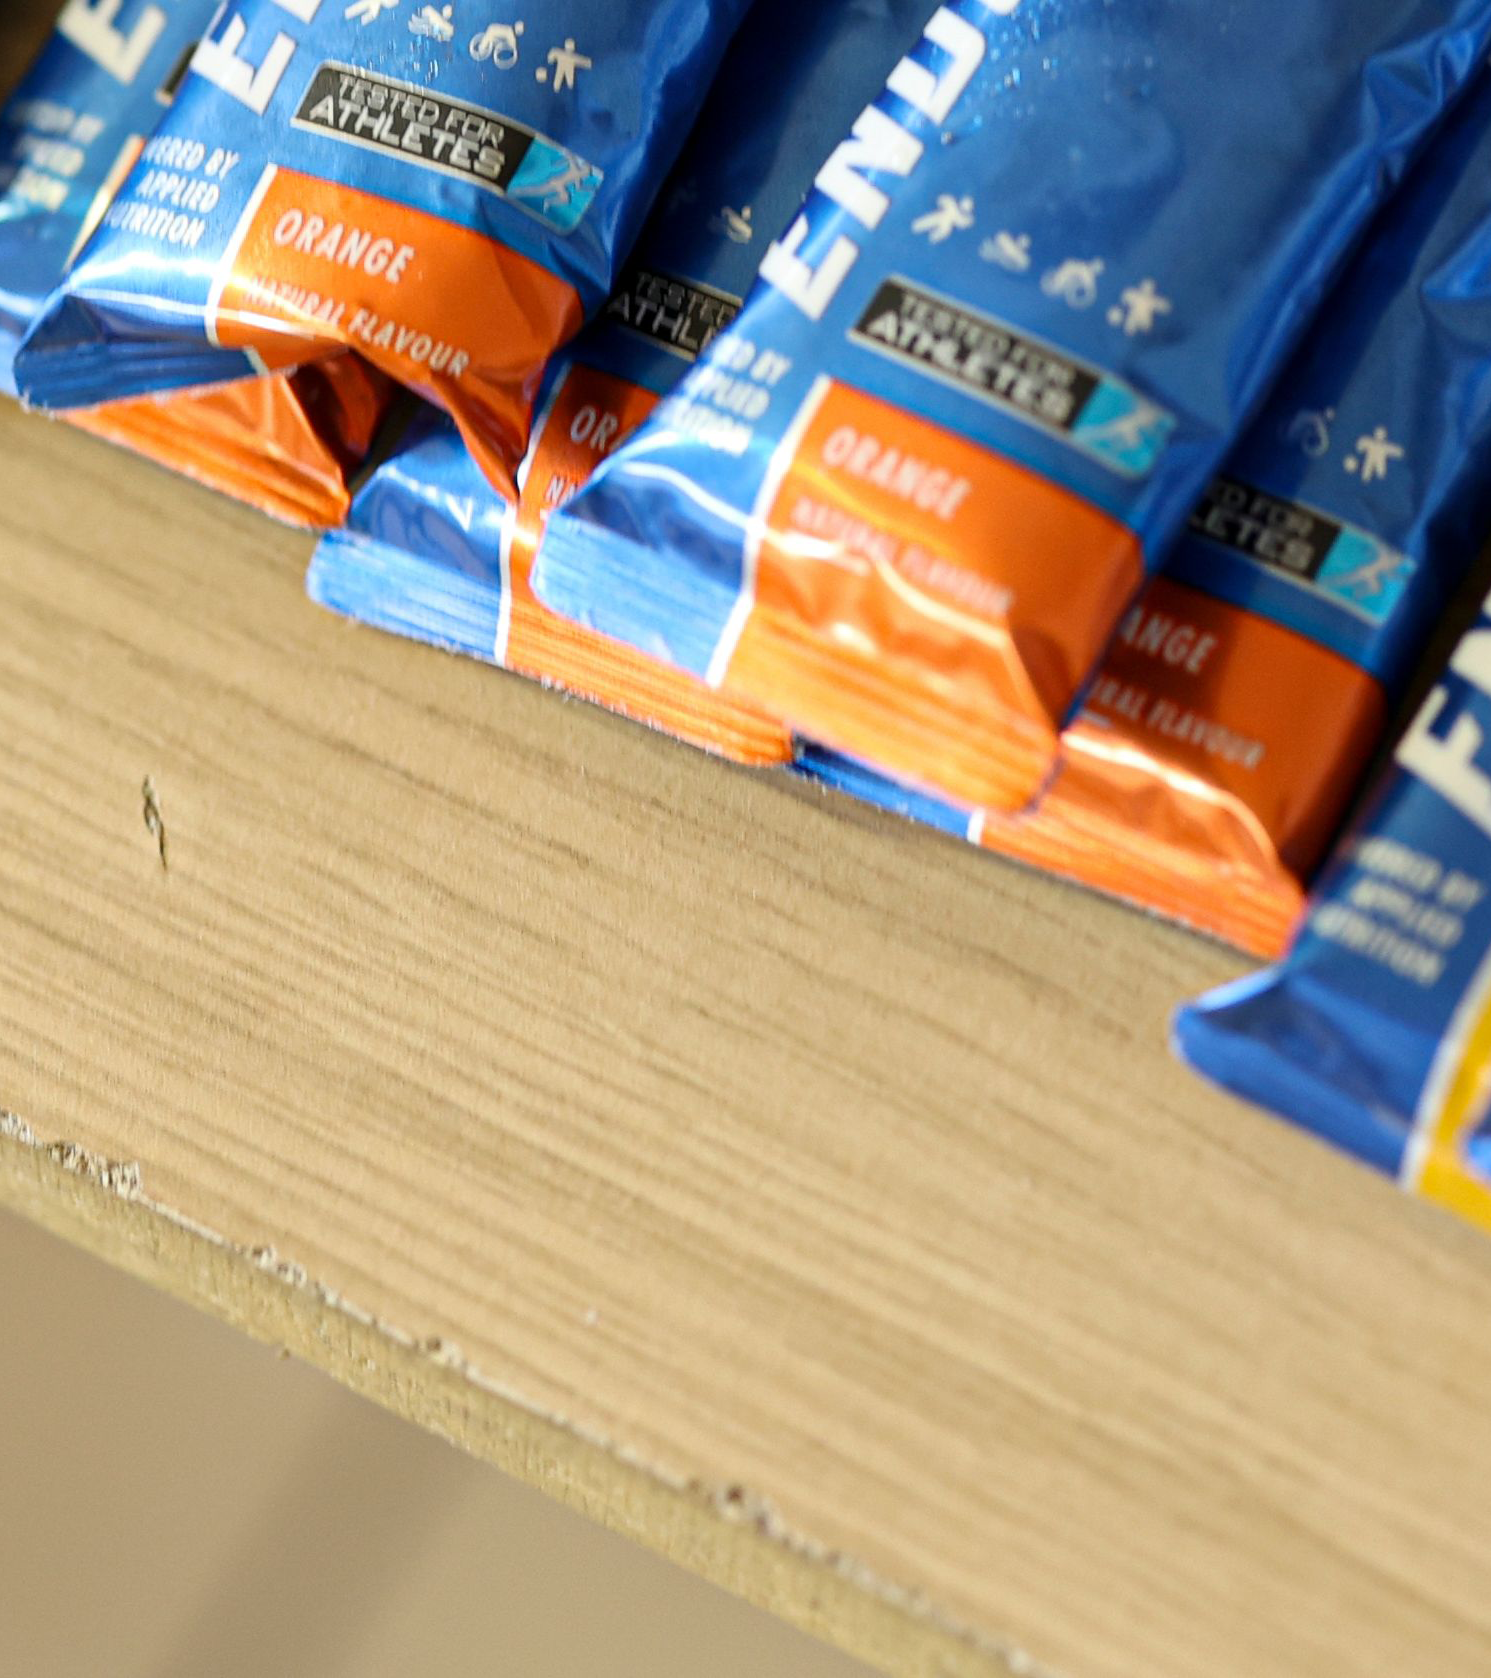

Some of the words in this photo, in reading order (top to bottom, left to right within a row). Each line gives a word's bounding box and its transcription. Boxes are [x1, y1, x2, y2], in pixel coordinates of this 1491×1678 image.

[308, 92, 507, 180] ATHLETES
[336, 72, 442, 128] TESTED
[440, 102, 508, 151] FOR
[136, 168, 222, 215] APPLIED
[204, 146, 241, 182] BY
[106, 200, 207, 250] UTRITION
[272, 208, 418, 287] ORANGE
[244, 276, 346, 340] NATURAL
[346, 306, 475, 381] FLAVOUR
[608, 292, 716, 348] ATHL
[820, 424, 973, 522] ORANGE
[1120, 603, 1218, 674] ANGE
